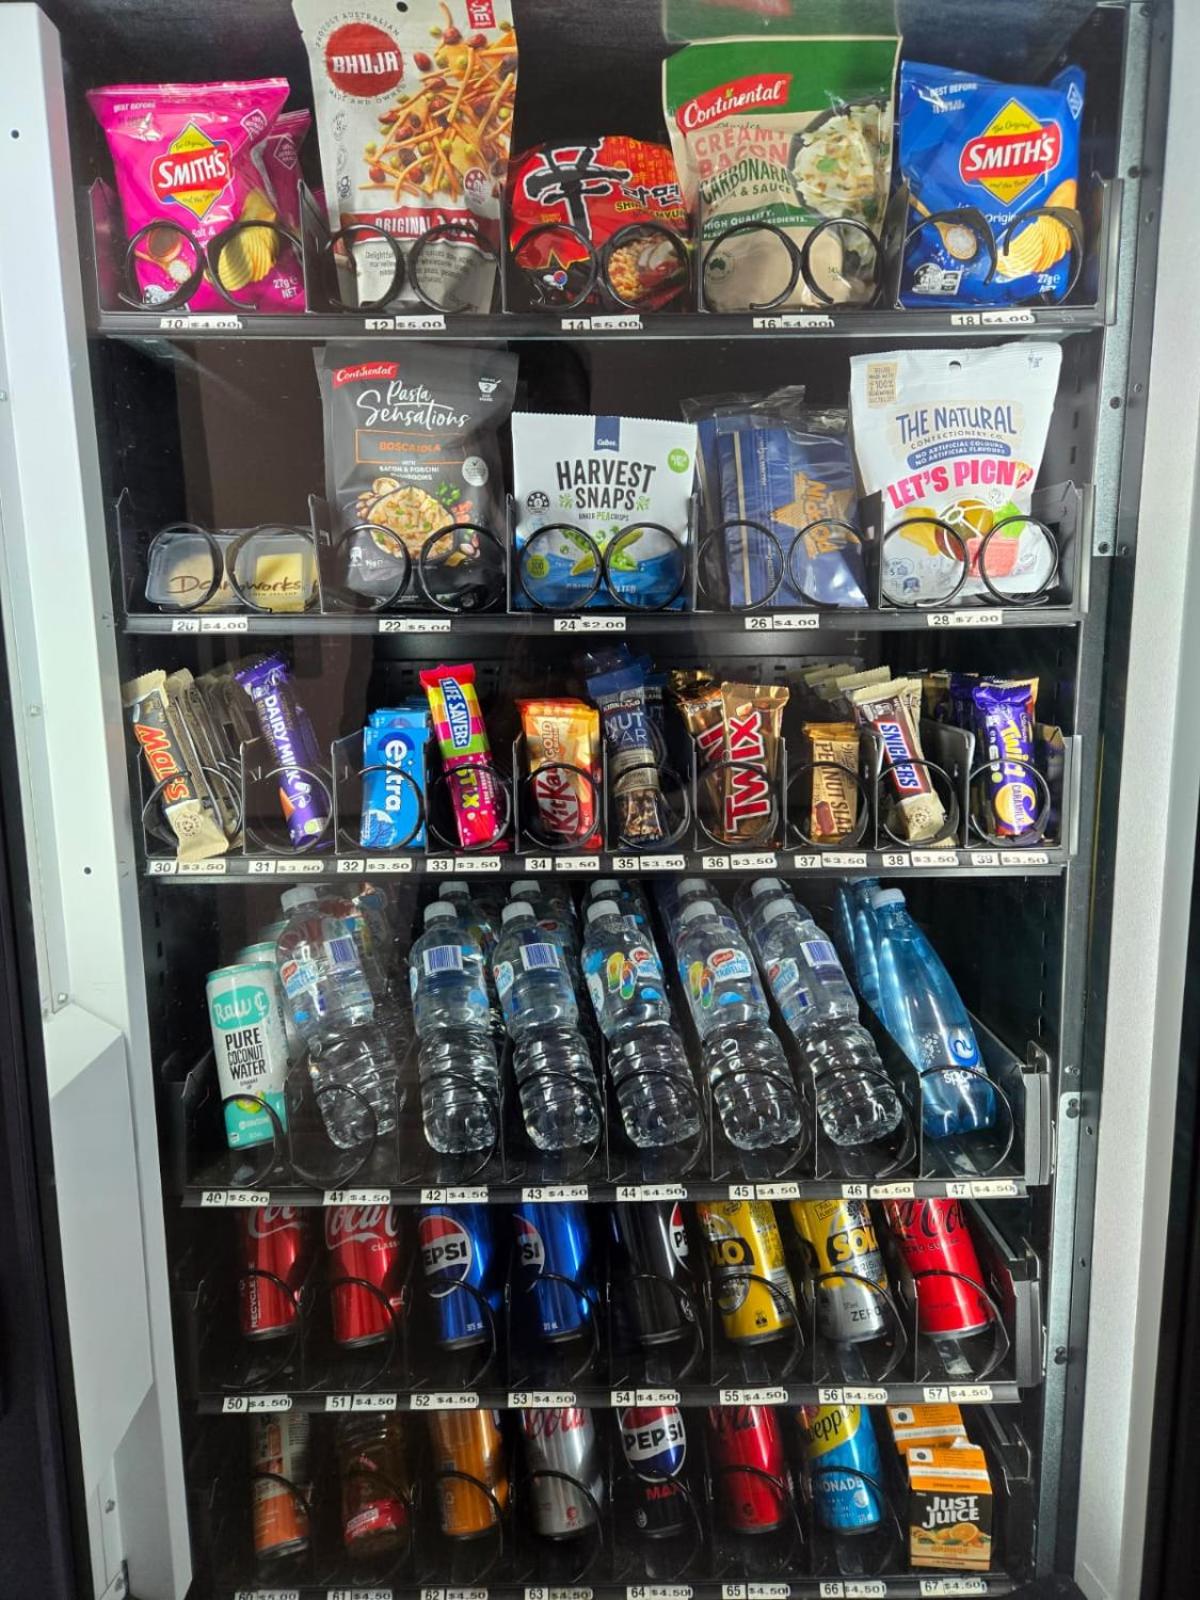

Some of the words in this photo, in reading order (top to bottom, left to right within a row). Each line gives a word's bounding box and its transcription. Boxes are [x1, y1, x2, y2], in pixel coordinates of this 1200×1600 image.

[332, 51, 398, 75] BHUJA
[683, 82, 784, 128] Continental
[965, 133, 1055, 171] SMITH'S
[157, 150, 226, 188] SMITH'S
[752, 183, 791, 195] SAUCE
[167, 319, 183, 329] 10
[371, 320, 388, 330] 12
[759, 318, 776, 328] 16
[958, 315, 974, 326] 18
[386, 380, 432, 408] Pasta
[356, 389, 471, 431] Sensations
[896, 410, 930, 445] THE
[935, 404, 1017, 435] NATURAL
[928, 441, 970, 454] ARTIFICIAL
[928, 448, 969, 462] ARTIFICIAL
[556, 459, 657, 494] HARVEST
[886, 465, 951, 510] LET'S
[576, 487, 637, 511] SNAPS
[203, 621, 246, 630] $4.00
[559, 620, 577, 632] 24
[582, 621, 625, 629] $2.00
[751, 618, 767, 630] 26
[774, 619, 817, 628] $4.00
[932, 615, 950, 626] 28
[955, 615, 998, 624] $7.00
[385, 621, 401, 632] 22
[443, 680, 461, 706] LIFE
[449, 702, 468, 746] SAVERS
[604, 711, 644, 735] NUT
[264, 694, 287, 750] DAIRY
[279, 743, 297, 785] MILK
[542, 720, 556, 759] GOLD
[880, 722, 919, 788] SNICKERS
[724, 710, 771, 832] TWIX
[432, 861, 448, 871] 33
[457, 861, 498, 869] $3.50
[530, 858, 546, 869] 34
[618, 858, 634, 869] 35
[641, 859, 682, 868] $3.50
[708, 858, 724, 868] 36
[733, 857, 774, 866] $3.50
[800, 857, 815, 867] 37
[824, 857, 865, 865] $3.50
[889, 856, 905, 866] 38
[154, 862, 172, 873] 30
[182, 862, 225, 872] $3.50
[255, 862, 271, 872] 31
[279, 863, 321, 871] $3.50
[342, 862, 358, 872] 32
[367, 862, 409, 870] $3.50
[225, 1027, 262, 1050] PURE
[227, 1044, 264, 1066] COCONUT
[229, 1060, 267, 1080] WATER
[426, 1190, 442, 1200] 42
[448, 1190, 489, 1199] $4.50
[527, 1189, 542, 1199] 43
[548, 1188, 587, 1197] $4.50
[621, 1187, 637, 1198] 44
[643, 1187, 681, 1196] $4.50
[733, 1186, 749, 1197] 45
[758, 1186, 797, 1195] $4.50
[847, 1185, 862, 1195] 46
[872, 1185, 912, 1194] $4.50
[951, 1184, 966, 1195] 47
[974, 1185, 1014, 1194] $4.50
[205, 1194, 222, 1204] 40
[329, 1193, 344, 1202] 41
[349, 1193, 391, 1203] $4.50
[513, 1394, 527, 1405] 53
[534, 1395, 574, 1404] $4.50
[616, 1393, 631, 1404] 54
[637, 1392, 675, 1401] $4.50
[725, 1391, 739, 1402] 55
[743, 1391, 782, 1401] $4.50
[823, 1390, 838, 1401] 56
[845, 1391, 883, 1400] $4.50
[928, 1389, 943, 1399] 57
[950, 1390, 988, 1398] $4.50
[227, 1398, 242, 1409] 50
[248, 1398, 287, 1408] $4.50
[331, 1396, 345, 1407] 51
[354, 1397, 394, 1406] $4.50
[415, 1395, 430, 1407] 52
[438, 1396, 476, 1404] $4.50
[623, 1420, 684, 1452] PEPSI
[926, 1495, 979, 1513] JUST
[922, 1507, 981, 1529] JUICE
[631, 1587, 646, 1598] 64
[651, 1588, 690, 1597] $4.50
[726, 1586, 740, 1597] 65
[748, 1587, 788, 1596] $4.50
[824, 1583, 839, 1594] 66
[845, 1585, 883, 1593] $4.50
[924, 1582, 938, 1592] 67
[944, 1582, 983, 1591] $4.50
[332, 1591, 346, 1600] 61
[425, 1590, 439, 1600] 62
[448, 1591, 486, 1600] $4.50
[529, 1589, 543, 1599] 63
